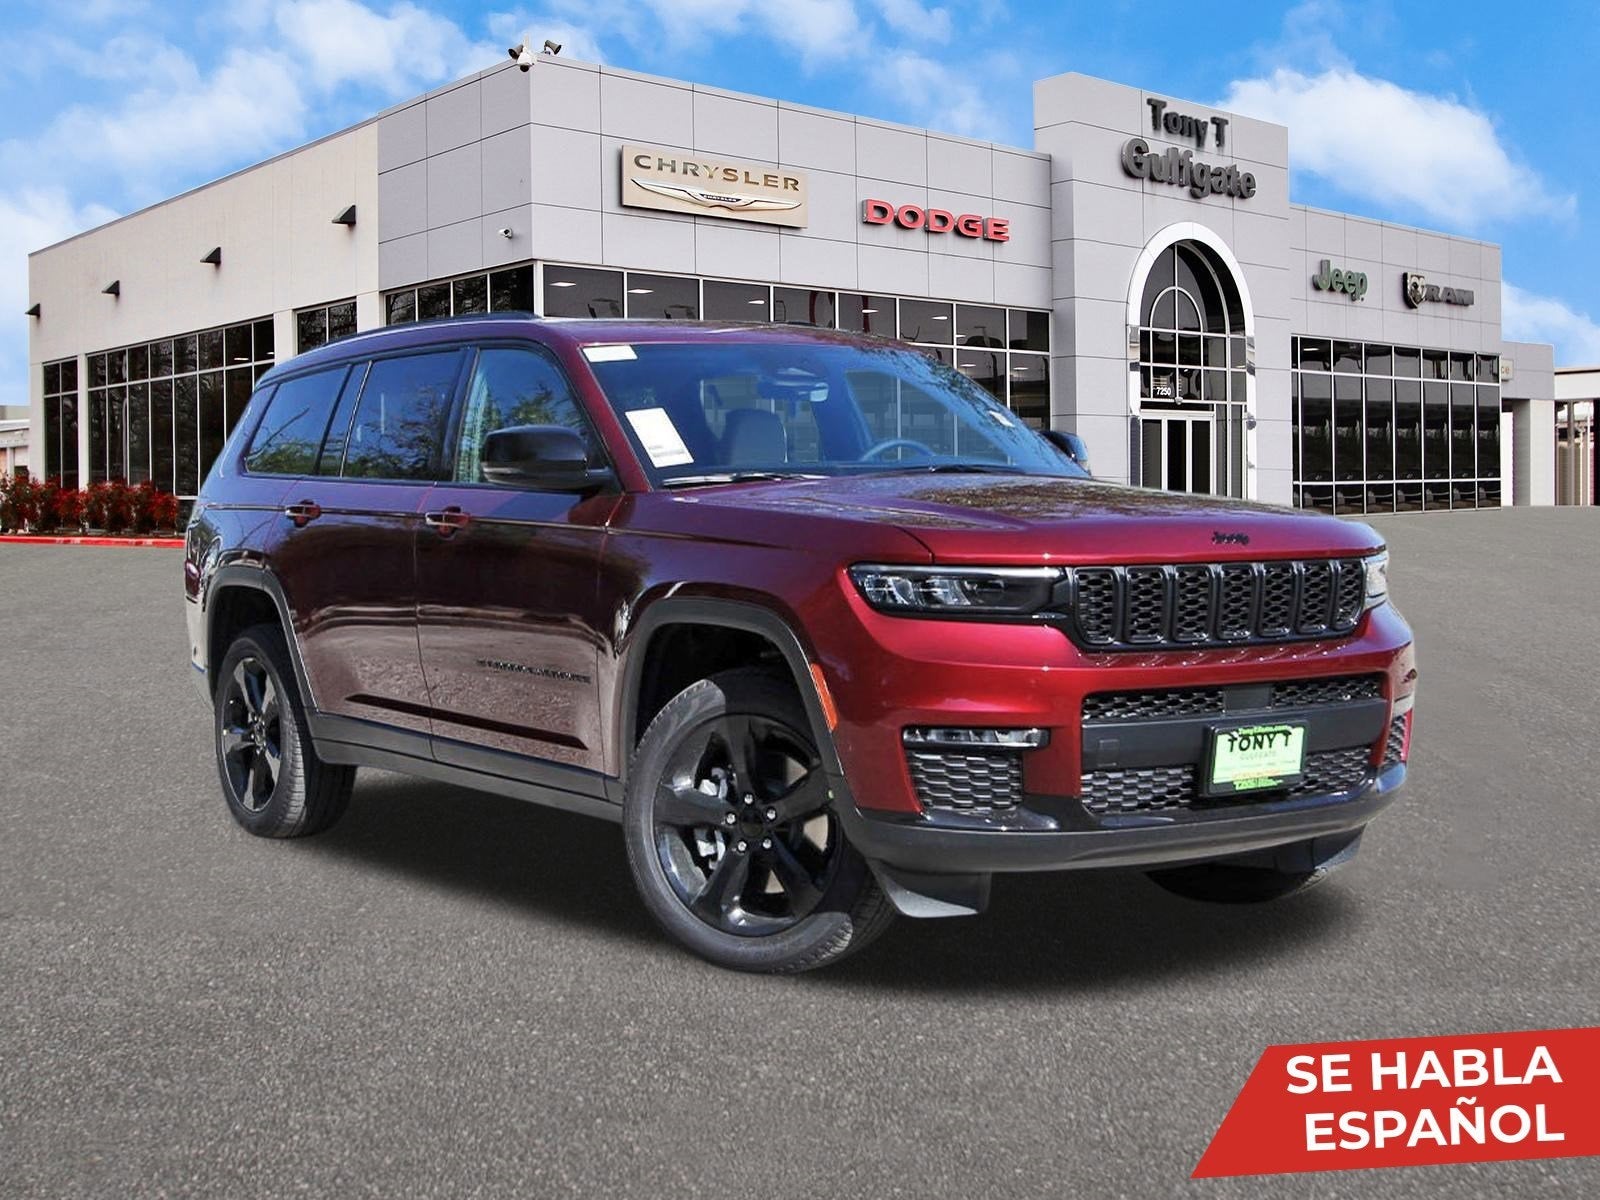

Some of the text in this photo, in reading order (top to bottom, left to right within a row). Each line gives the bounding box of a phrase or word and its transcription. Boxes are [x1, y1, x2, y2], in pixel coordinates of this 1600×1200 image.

[1147, 98, 1229, 148] Tony T
[633, 154, 800, 192] CHRYSLER
[1121, 138, 1257, 199] Gulfgate
[863, 198, 1010, 242] DODGE
[1312, 259, 1368, 302] Jeep
[1425, 284, 1475, 306] RAM
[1156, 387, 1172, 396] 7250
[1228, 730, 1292, 753] TONY T
